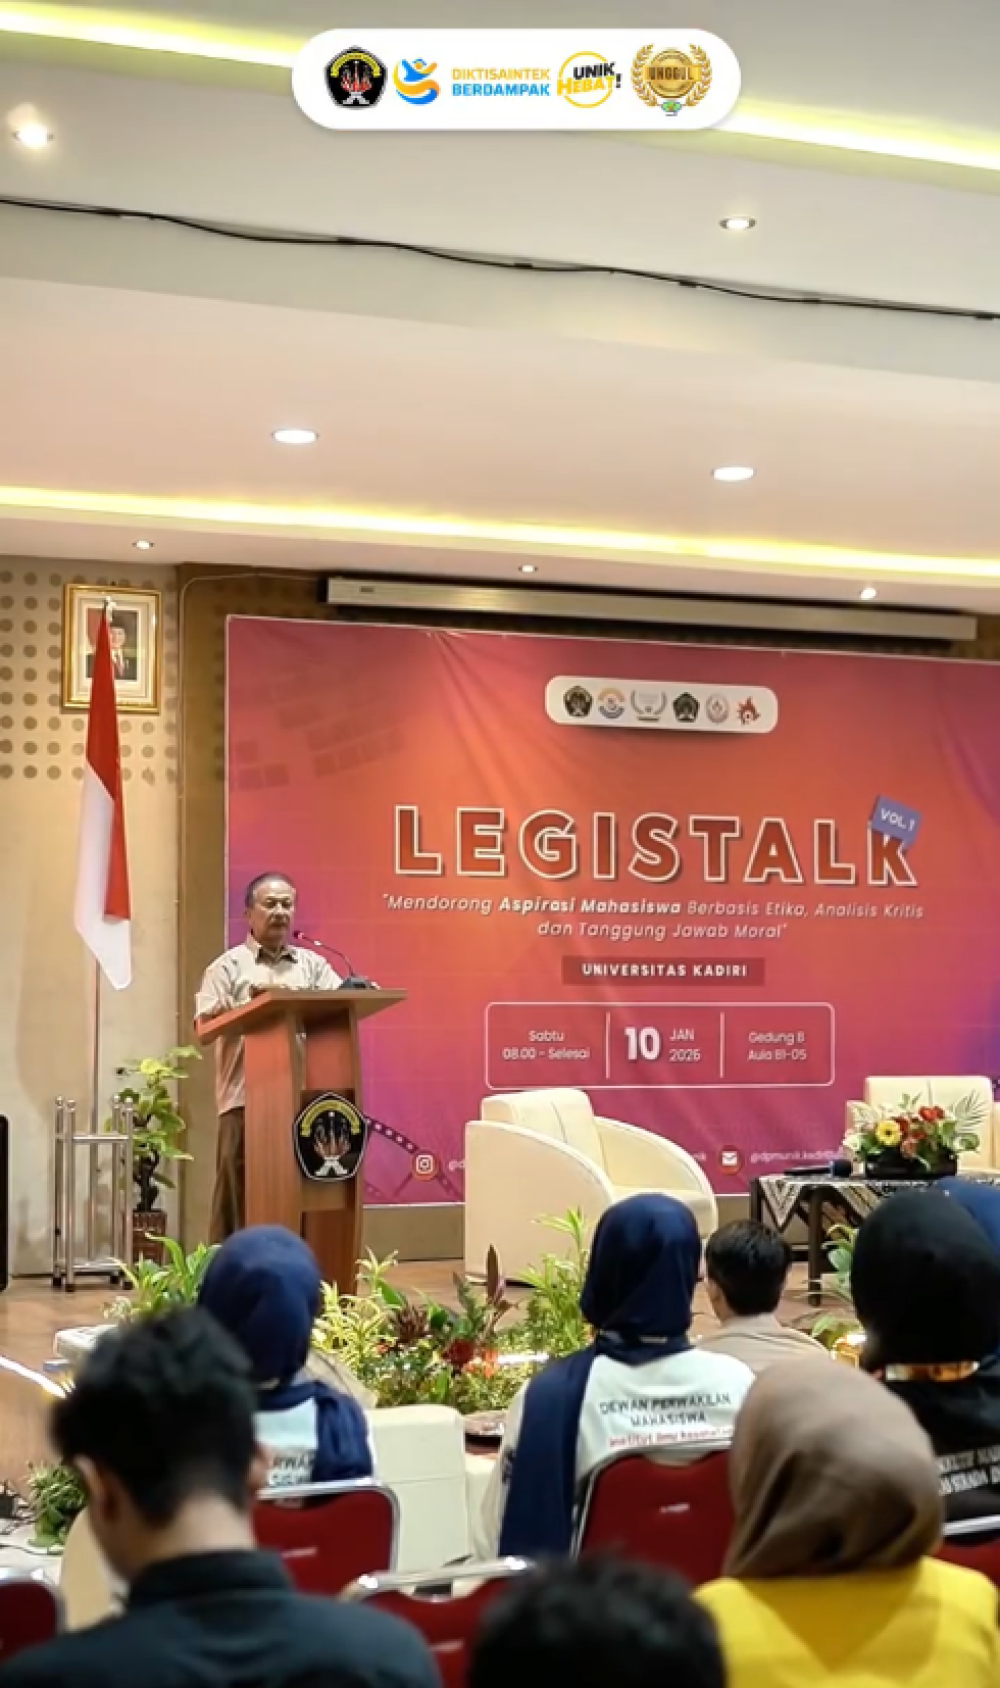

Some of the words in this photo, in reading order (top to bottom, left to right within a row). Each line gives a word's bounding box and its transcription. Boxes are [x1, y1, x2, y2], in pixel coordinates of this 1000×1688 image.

[394, 805, 917, 886] LEGISTALK
[499, 896, 575, 915] Aspirasi
[580, 898, 681, 915] Mahasiswa
[687, 901, 760, 916] Berbasis
[764, 902, 808, 918] Etika,
[814, 902, 878, 917] Analisis
[883, 903, 924, 918] Kritis
[538, 920, 572, 936] dan
[580, 922, 666, 941] Tanggung
[672, 923, 728, 938] Jawab
[581, 962, 687, 977] UNIVERSITAS
[693, 964, 748, 977] KADIRI
[528, 1029, 565, 1042] Sabtu
[669, 1028, 695, 1041] JAN
[748, 1030, 795, 1045] Gedung
[797, 1030, 805, 1043] B
[624, 1026, 661, 1060] 10
[502, 1047, 536, 1060] 08.00
[548, 1047, 590, 1060] Selesai
[669, 1048, 701, 1062] 2026
[747, 1048, 772, 1060] Aula
[599, 1399, 648, 1415] DEWAN
[651, 1392, 730, 1409] PERWAKILAN
[631, 1411, 706, 1427] MAHASISWA
